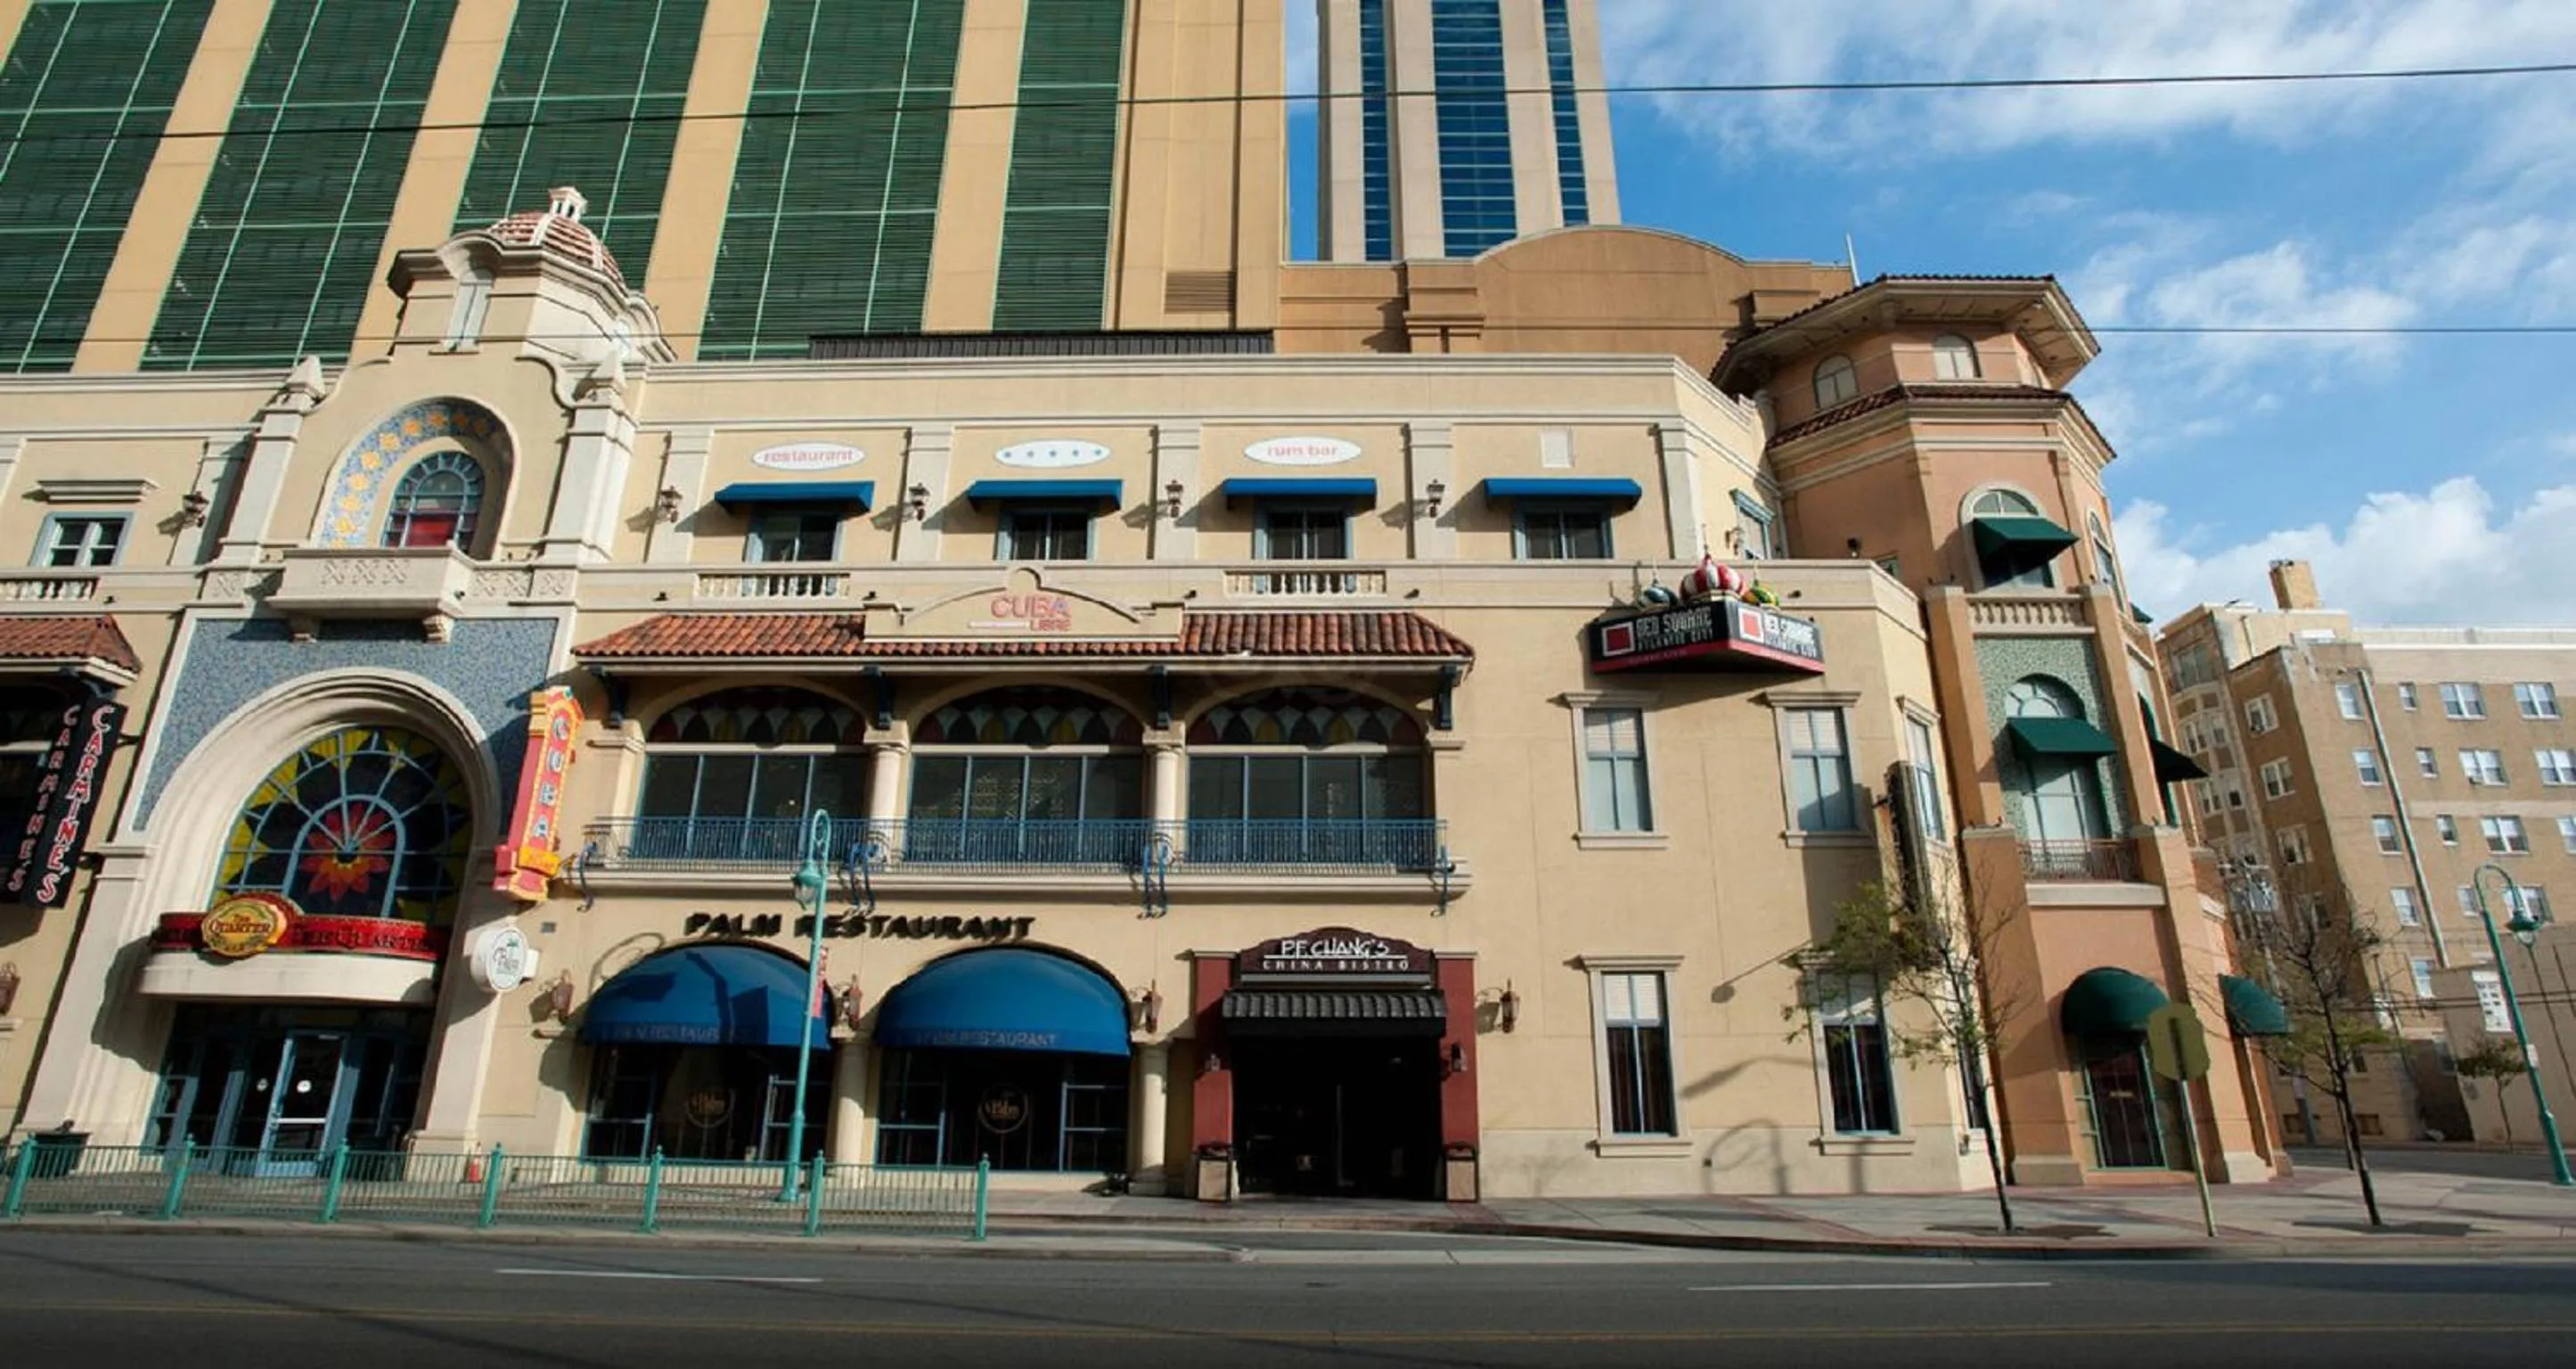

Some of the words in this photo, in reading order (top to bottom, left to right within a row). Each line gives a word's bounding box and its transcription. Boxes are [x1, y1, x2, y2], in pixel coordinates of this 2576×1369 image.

[764, 448, 853, 463] restaurant
[1267, 447, 1303, 456] rum
[1308, 444, 1337, 456] bar
[990, 594, 1071, 618] CUBA
[1662, 606, 1712, 633] SQUARE
[37, 704, 115, 903] CARMINE'S
[683, 912, 782, 939] PALM
[794, 914, 1036, 941] RESTAURANT
[1262, 960, 1324, 971] CHINA
[1337, 959, 1410, 971] BISTRO
